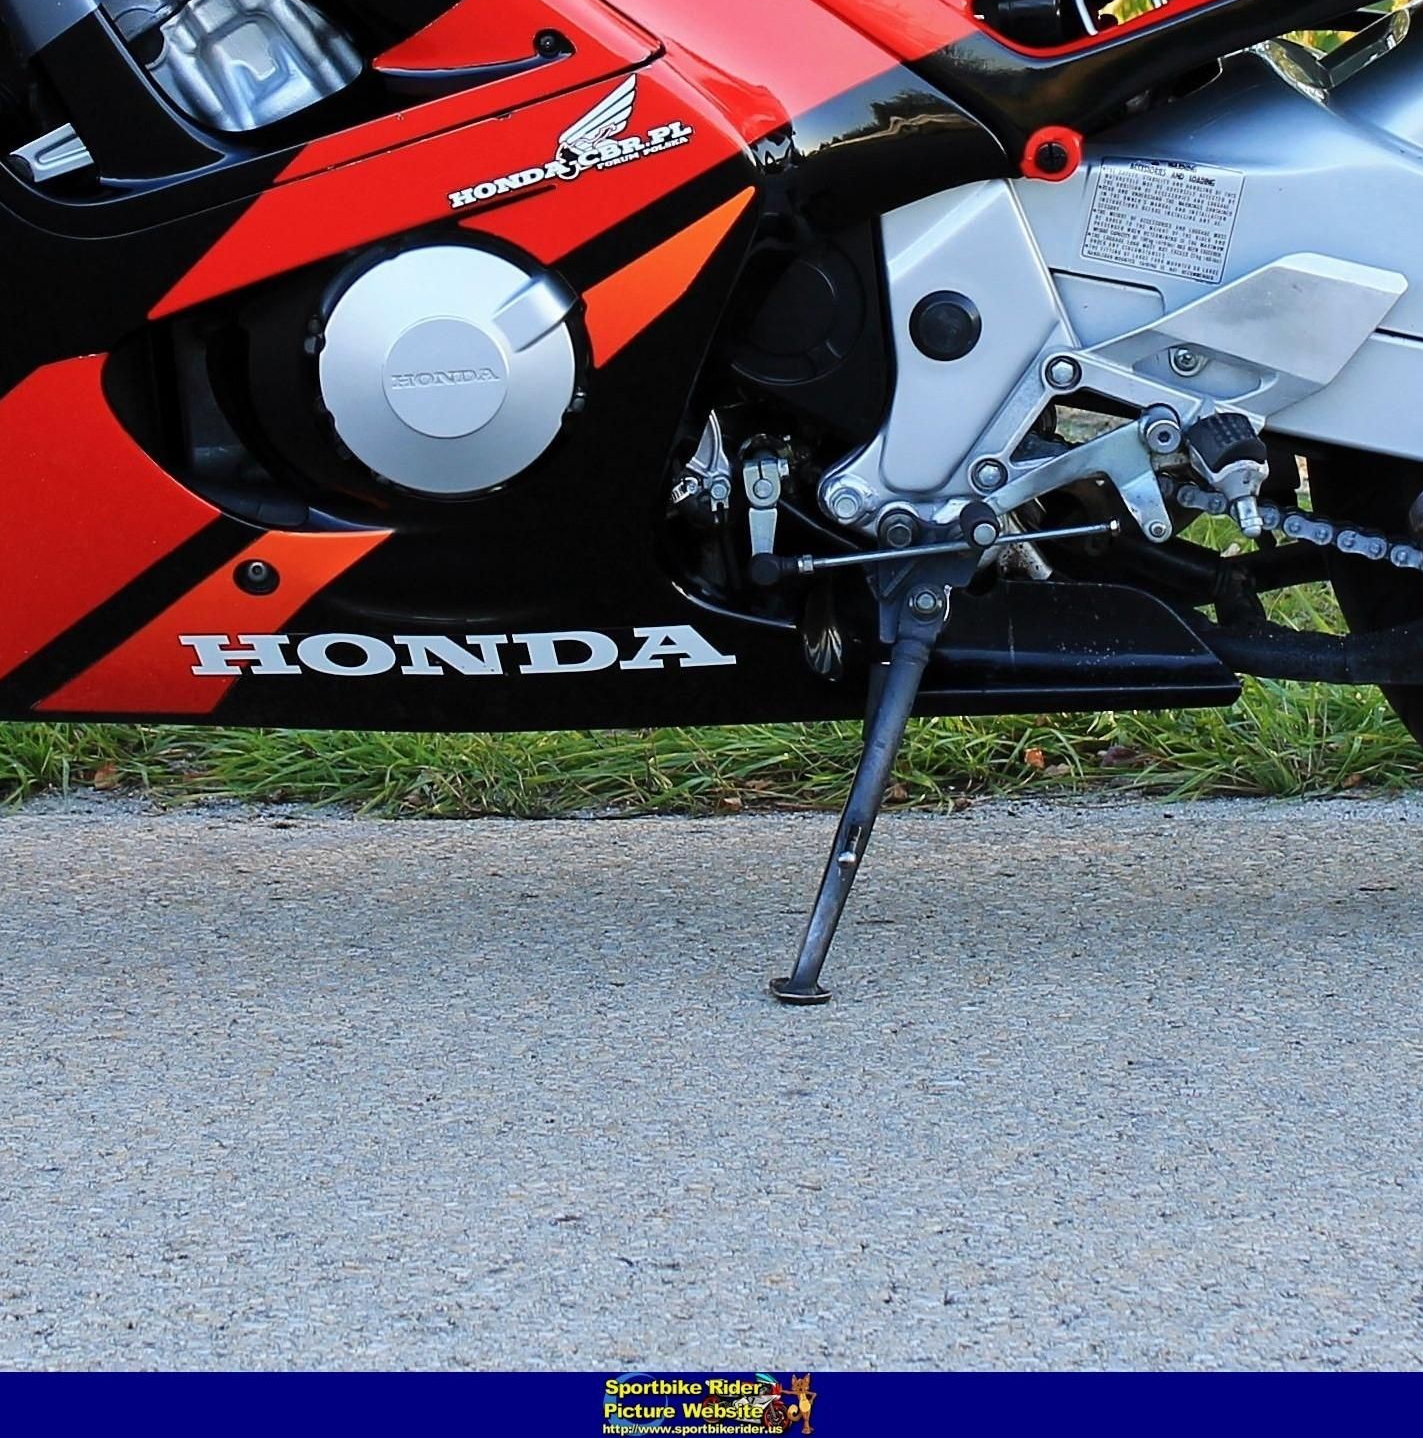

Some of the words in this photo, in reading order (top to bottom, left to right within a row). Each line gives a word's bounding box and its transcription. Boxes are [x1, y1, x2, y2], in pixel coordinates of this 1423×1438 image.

[642, 137, 689, 157] POLSKA
[448, 160, 571, 208] HONDA
[391, 367, 502, 390] HONDA
[178, 624, 737, 676] HONDA
